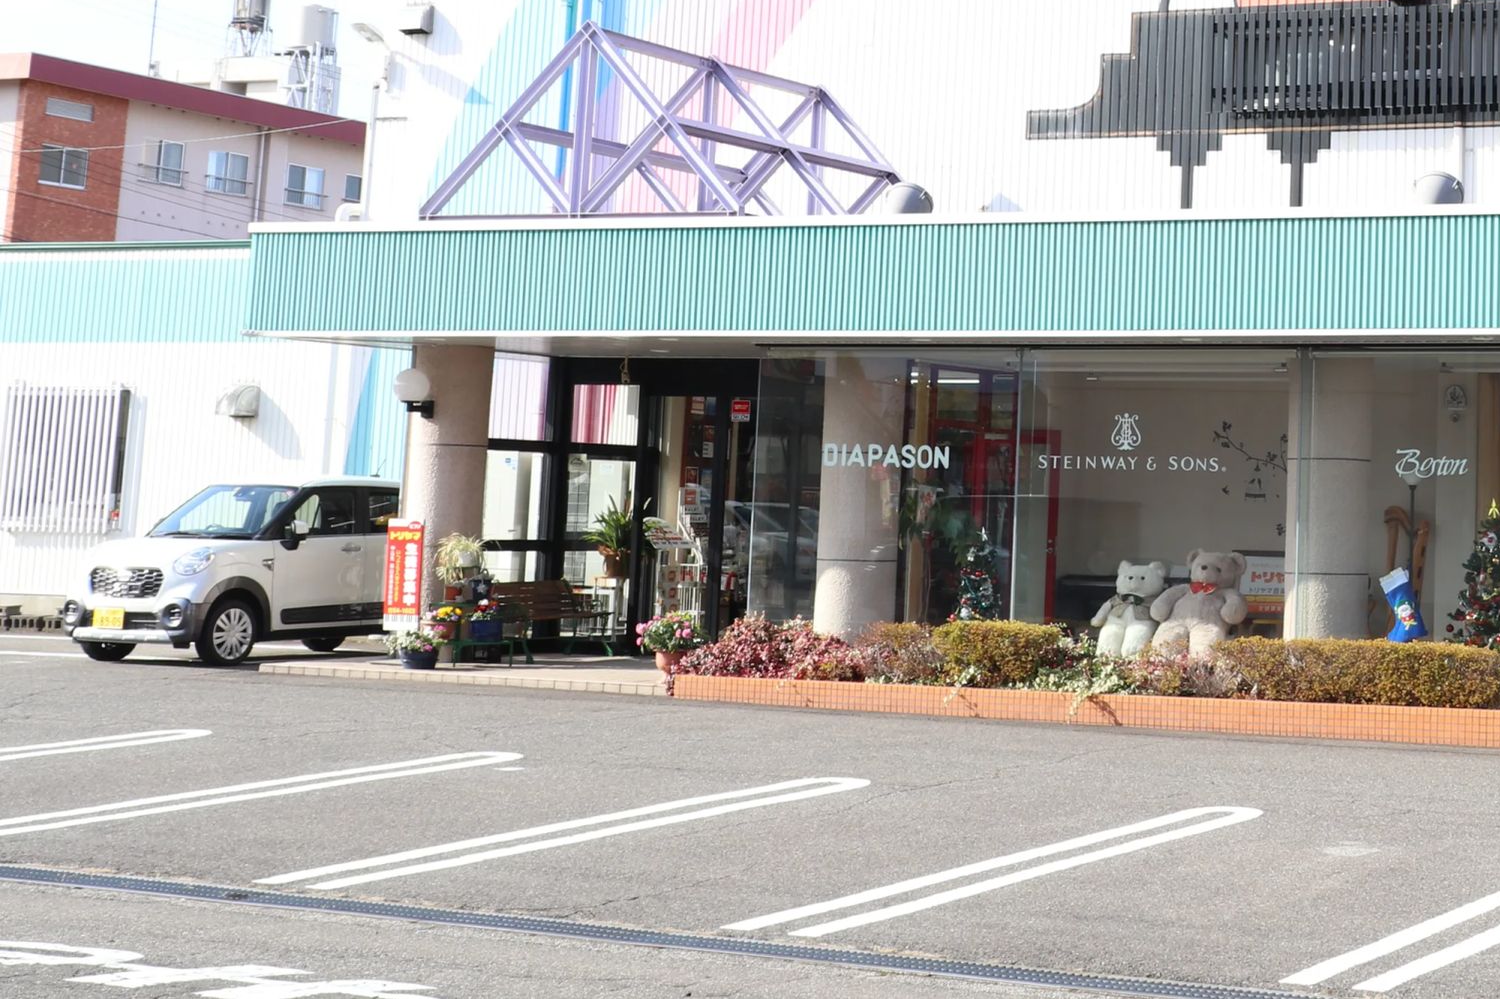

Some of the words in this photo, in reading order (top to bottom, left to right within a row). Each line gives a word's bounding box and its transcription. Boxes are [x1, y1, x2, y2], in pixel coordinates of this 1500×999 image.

[823, 443, 950, 470] DIAPASON
[1038, 455, 1138, 470] STEINWAY
[1146, 456, 1157, 471] &
[1395, 448, 1468, 479] Boston
